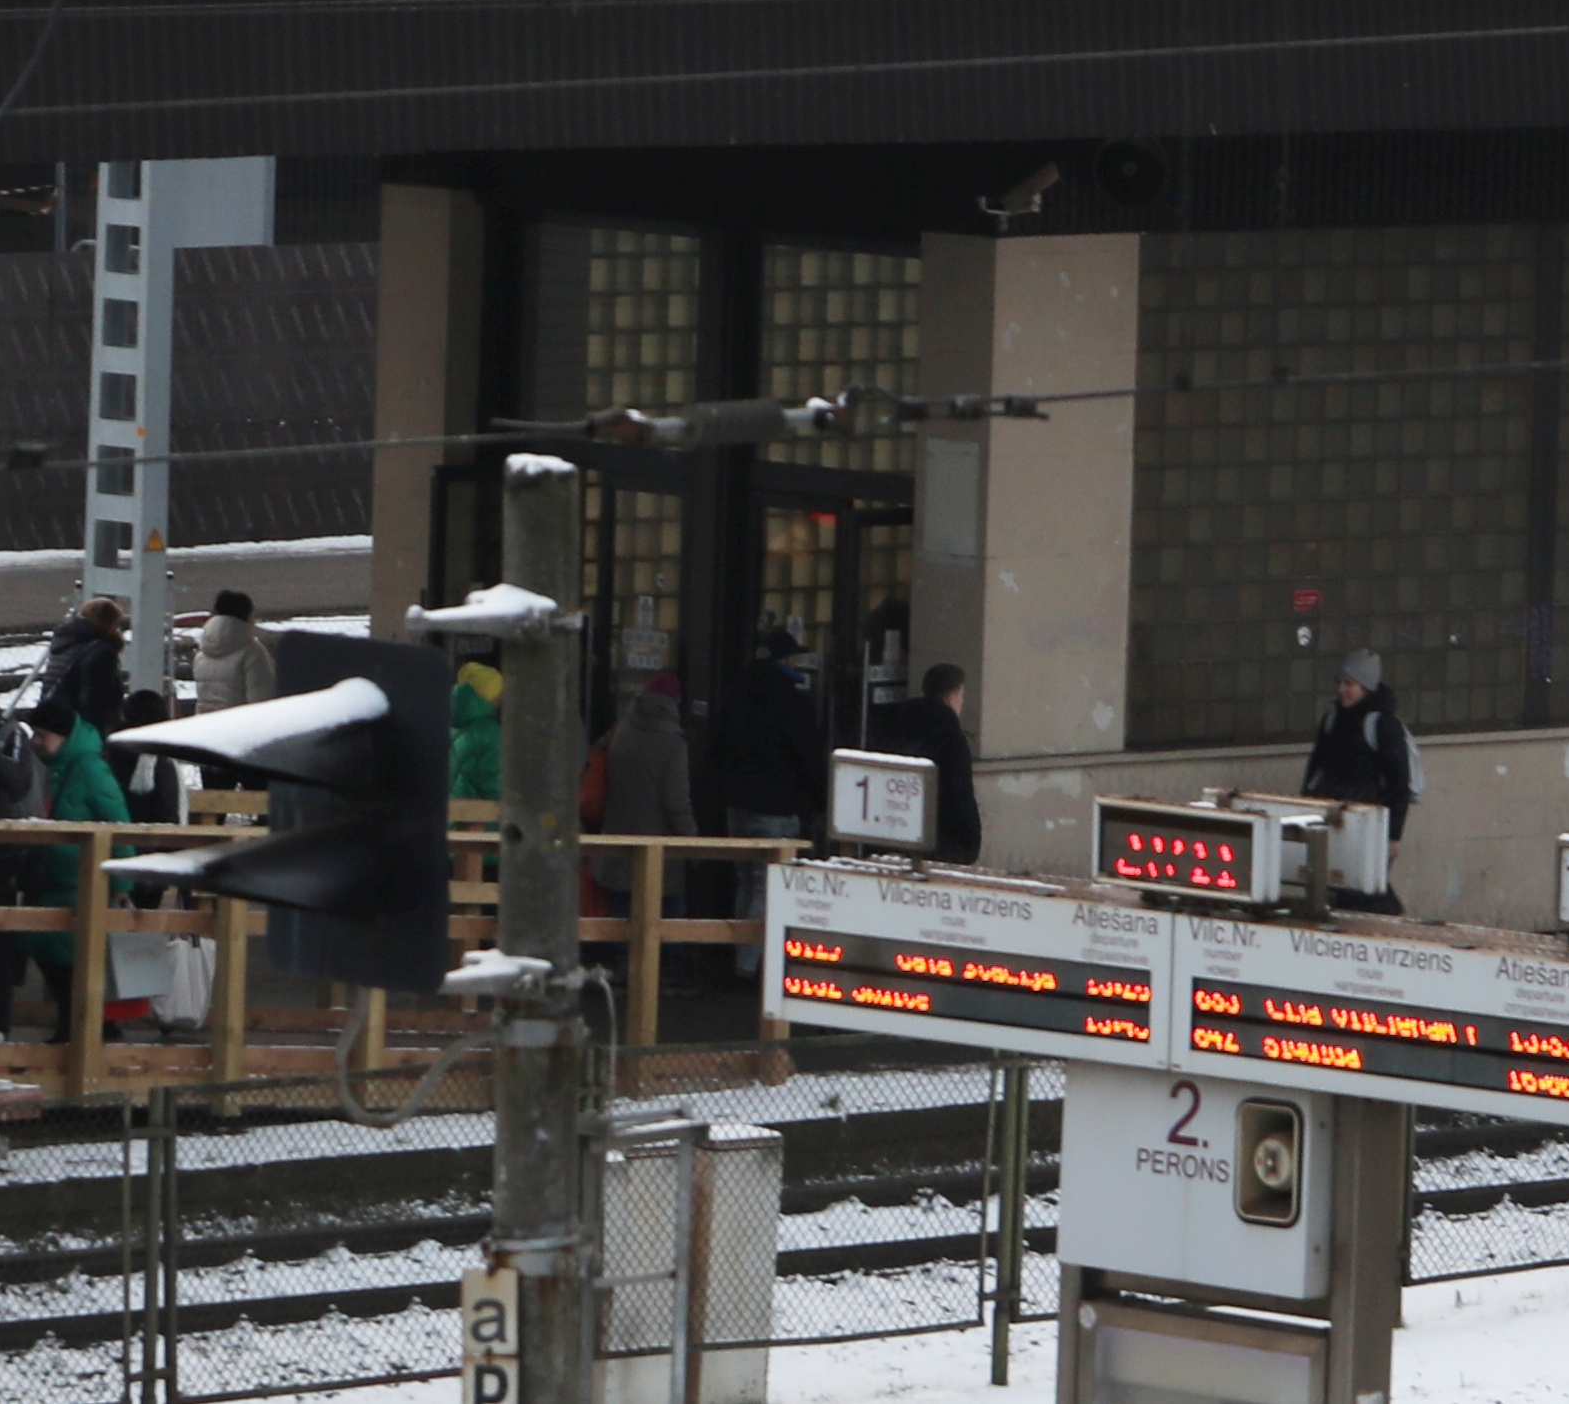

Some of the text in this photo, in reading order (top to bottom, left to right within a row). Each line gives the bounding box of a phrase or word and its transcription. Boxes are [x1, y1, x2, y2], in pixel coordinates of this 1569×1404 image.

[877, 880, 1033, 921] Vilciena virziens
[1290, 929, 1454, 974] Vilciena virziens
[1136, 1147, 1231, 1184] PERONS
